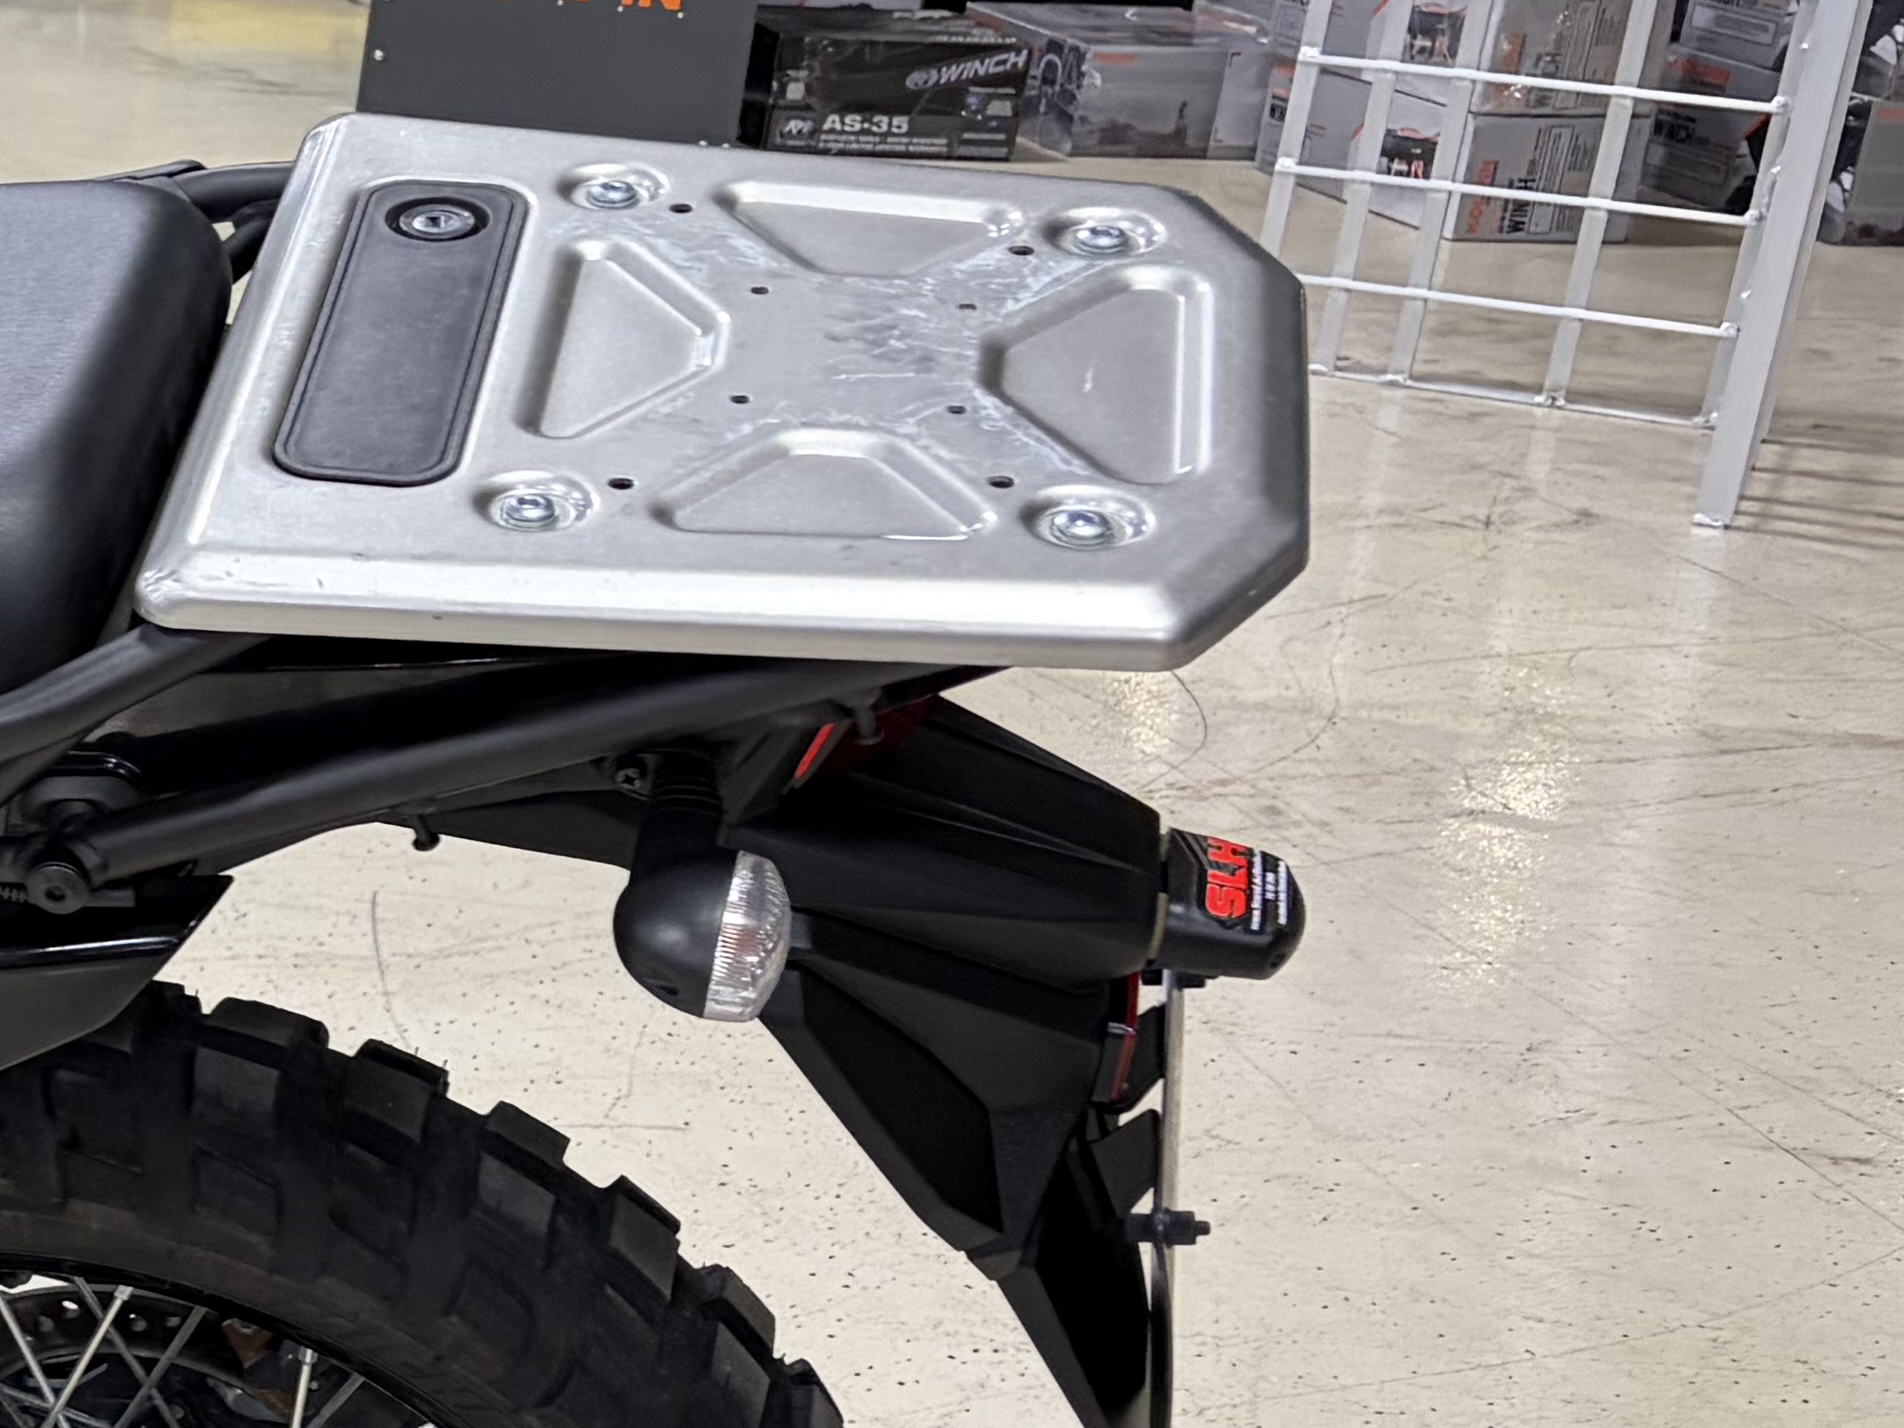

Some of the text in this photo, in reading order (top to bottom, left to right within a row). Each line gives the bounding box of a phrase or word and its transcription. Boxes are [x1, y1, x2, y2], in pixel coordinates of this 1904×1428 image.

[938, 49, 1030, 86] WINCH
[1505, 177, 1536, 235] WINH
[1205, 835, 1248, 917] SLH
